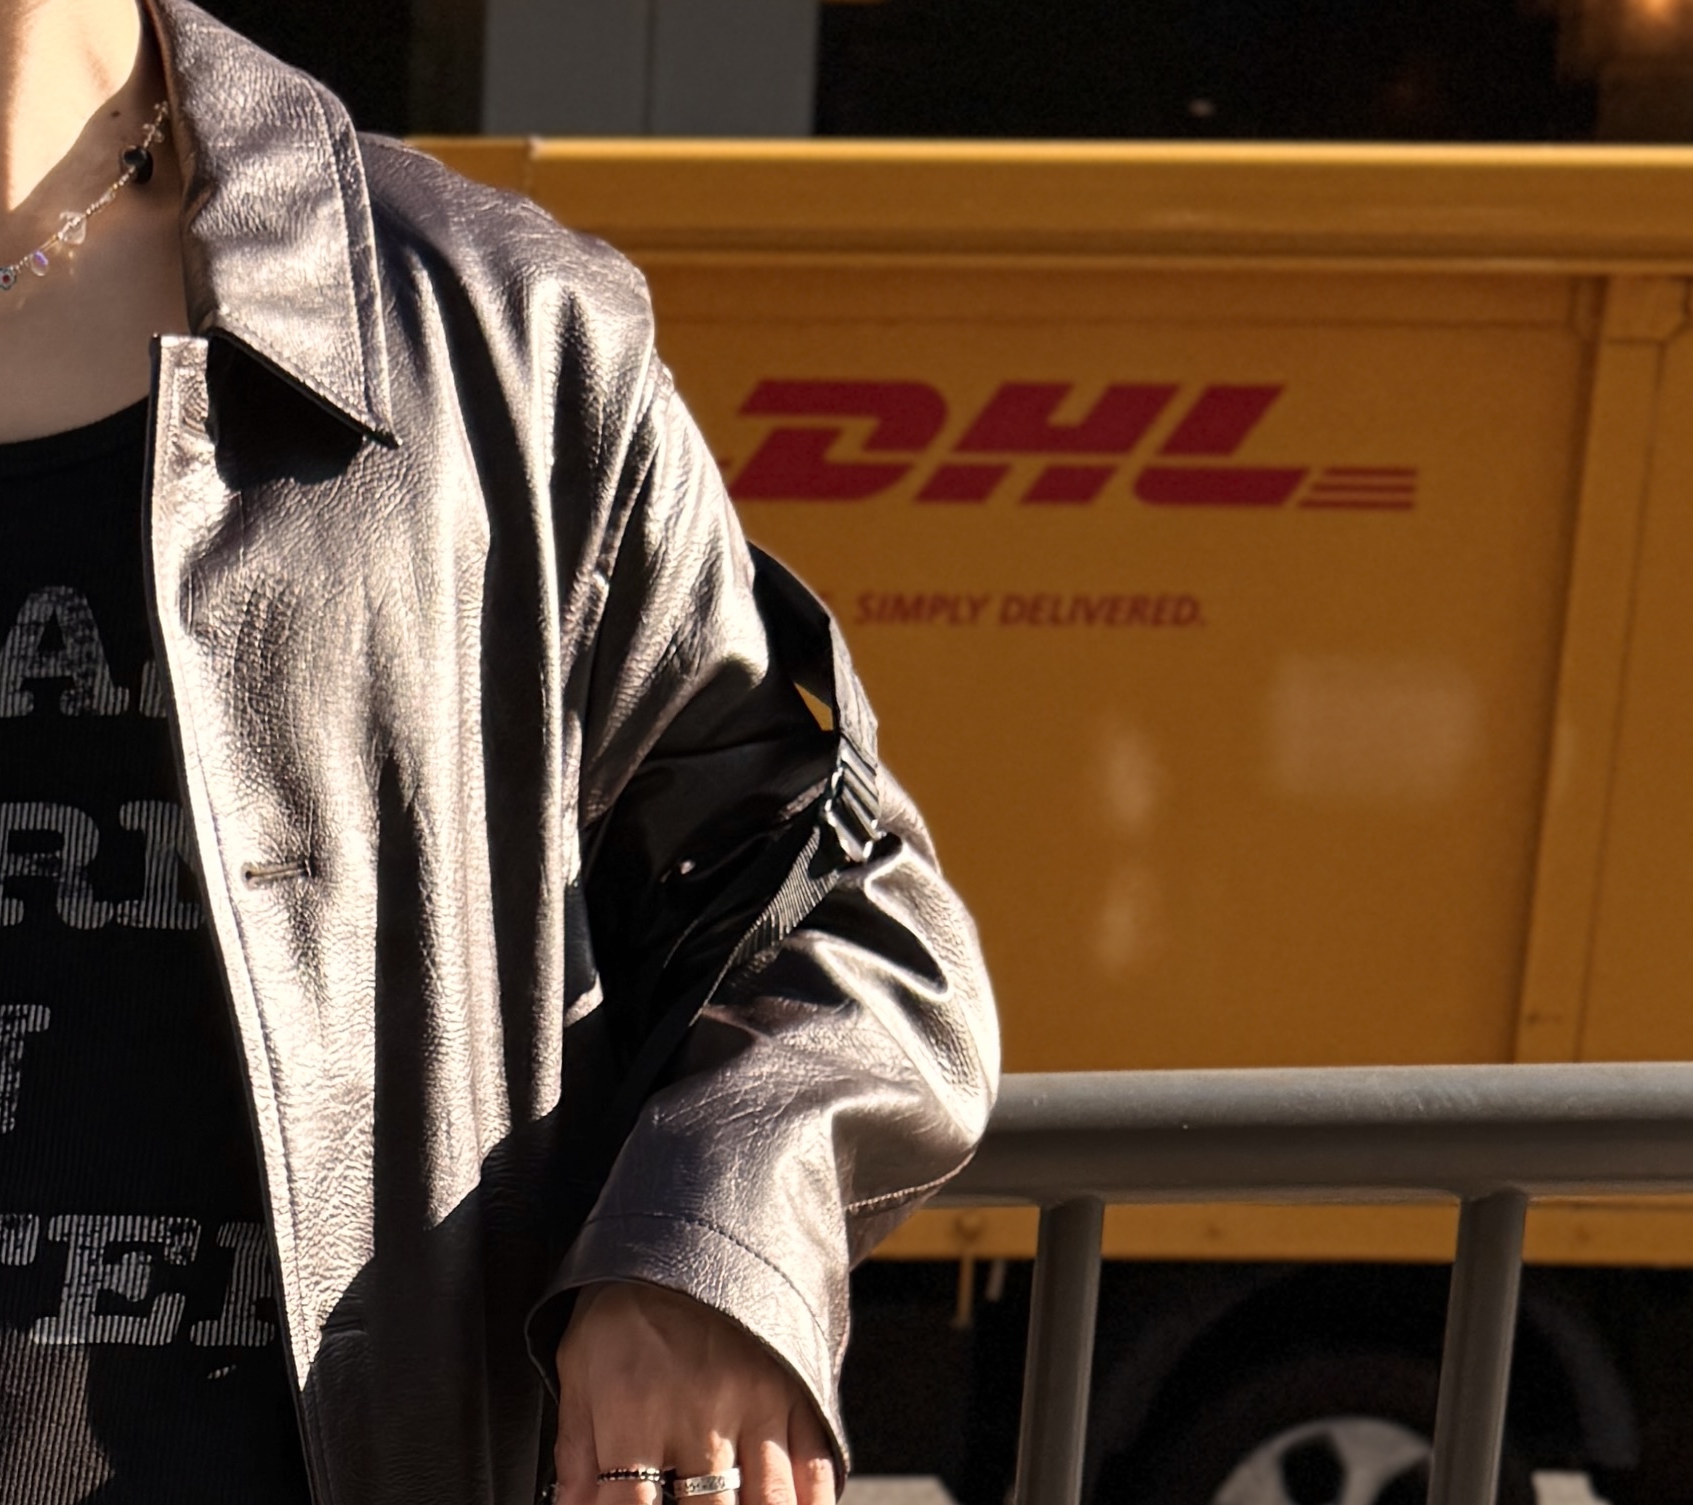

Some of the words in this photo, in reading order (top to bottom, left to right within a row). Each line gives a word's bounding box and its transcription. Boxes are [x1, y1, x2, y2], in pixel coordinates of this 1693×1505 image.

[728, 379, 1314, 509] DHL
[854, 592, 989, 627] SIMPLY
[998, 593, 1207, 629] DELIVERED.
